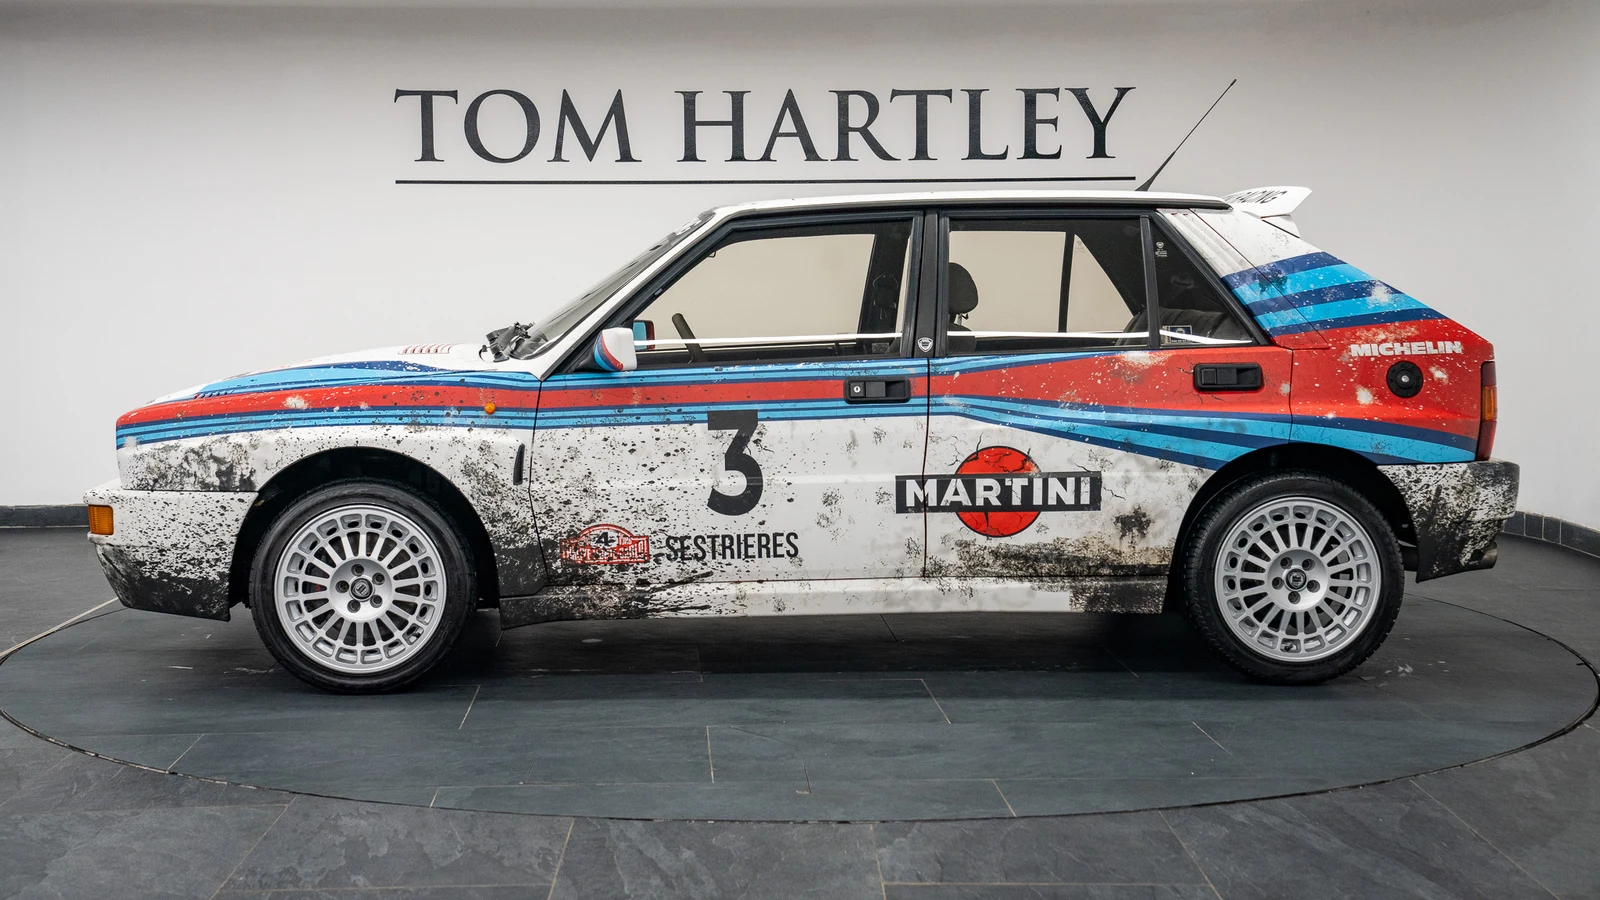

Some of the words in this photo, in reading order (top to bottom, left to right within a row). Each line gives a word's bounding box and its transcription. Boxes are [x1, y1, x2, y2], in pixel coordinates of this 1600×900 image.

[394, 88, 642, 163] TOM
[675, 86, 1136, 163] HARTLEY
[1350, 341, 1463, 357] MICHELIN
[707, 409, 763, 516] 3
[905, 476, 1091, 507] MARTINI
[665, 532, 799, 562] SESTRIERES
